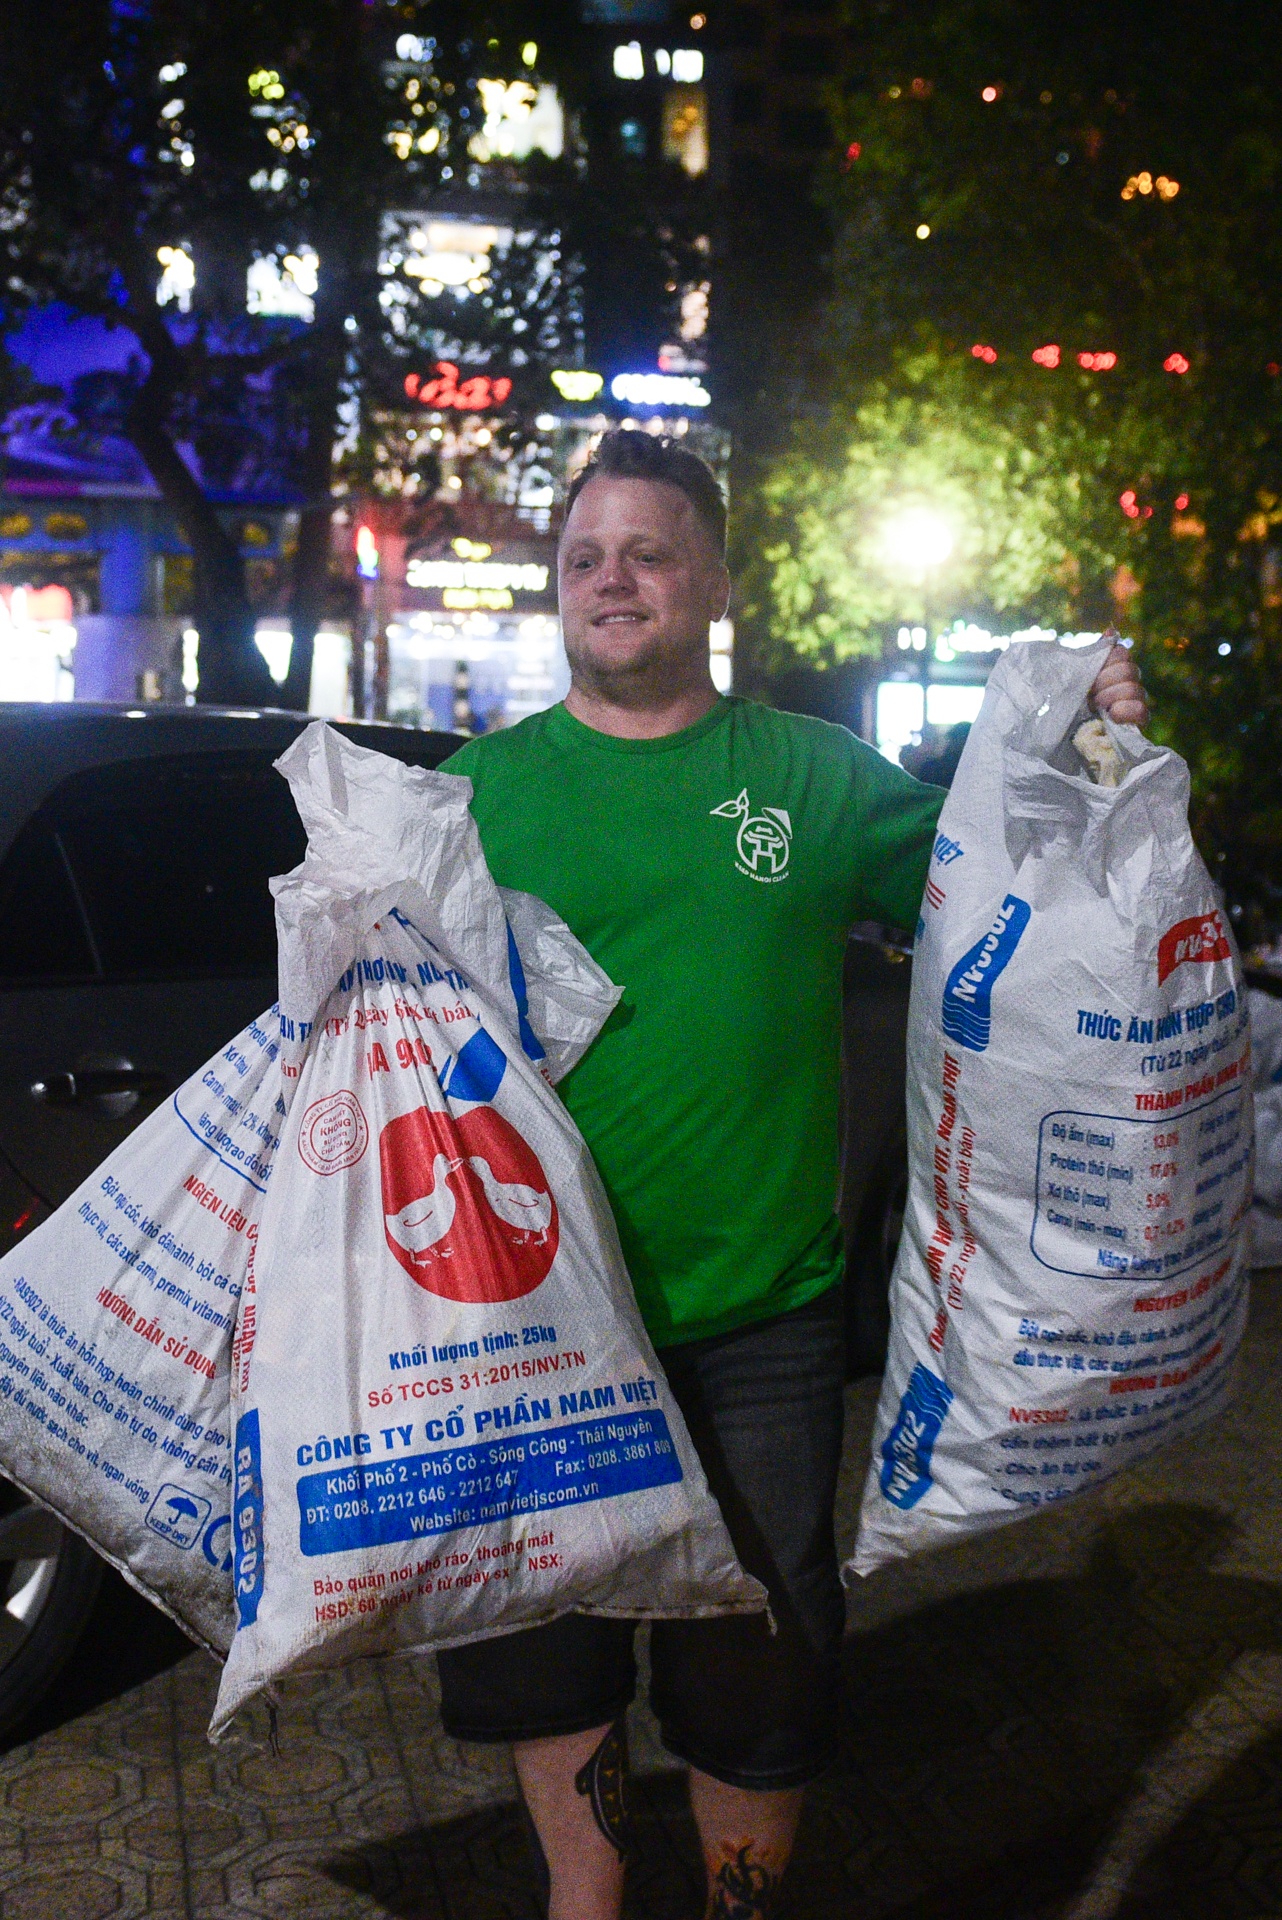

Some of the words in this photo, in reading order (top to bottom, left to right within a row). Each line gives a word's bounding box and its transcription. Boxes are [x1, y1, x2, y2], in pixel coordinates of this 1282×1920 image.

[1077, 1009, 1122, 1041] THỨC
[1126, 1015, 1153, 1044] ĂN
[949, 1264, 967, 1284] 22
[958, 1126, 977, 1158] bán)
[106, 1232, 123, 1252] các
[154, 1276, 193, 1308] premix
[196, 1258, 216, 1281] bột
[214, 1273, 231, 1290] cá
[133, 1317, 165, 1346] DẪN
[163, 1336, 188, 1359] SỬ
[389, 1344, 428, 1371] Khối
[432, 1341, 479, 1364] lượng
[483, 1331, 519, 1355] tịnh:
[523, 1325, 557, 1346] 25kg
[30, 1368, 48, 1392] liệu
[48, 1387, 66, 1407] nào
[38, 1303, 51, 1322] là
[46, 1313, 67, 1340] thức
[65, 1331, 79, 1351] ăn
[77, 1342, 98, 1367] hỗn
[94, 1357, 115, 1383] hợp
[115, 1372, 143, 1401] hoàn
[175, 1412, 204, 1440] dùng
[204, 1428, 225, 1447] cho
[368, 1384, 394, 1408] Số
[398, 1377, 454, 1401] TCCS
[460, 1350, 586, 1391] 31:2015/NV.TN
[92, 1390, 114, 1414] Cho
[114, 1405, 129, 1425] ăn
[129, 1416, 144, 1436] tự
[142, 1426, 158, 1448] do,
[161, 1436, 197, 1469] không
[197, 1455, 219, 1476] cần
[296, 1435, 372, 1467] CÔNG
[380, 1424, 414, 1450] TY
[425, 1404, 465, 1442] CỔ
[474, 1393, 551, 1434] PHẦN
[559, 1386, 615, 1417] NAM
[621, 1376, 658, 1406] VIỆT
[67, 1436, 86, 1455] cho
[101, 1460, 125, 1483] ngan
[238, 1447, 253, 1500] RA
[306, 1506, 330, 1525] ĐT:
[334, 1500, 375, 1520] 0208.
[378, 1491, 415, 1513] 2212
[418, 1486, 446, 1505] 646
[459, 1475, 492, 1497] 2212
[495, 1470, 518, 1489] 647
[555, 1459, 585, 1477] Fax:
[588, 1451, 621, 1470] 0208.
[624, 1445, 653, 1462] 3861
[326, 1470, 360, 1495] Khối
[364, 1463, 396, 1489] Phố
[398, 1465, 408, 1483] 2
[421, 1453, 453, 1478] Phố
[456, 1453, 477, 1472] Cò
[489, 1445, 526, 1466] Sông
[528, 1437, 567, 1457] Công
[577, 1428, 604, 1446] Thái
[607, 1418, 653, 1442] Nguyên
[150, 1517, 172, 1535] KEEP
[172, 1528, 191, 1546] DRY
[410, 1507, 476, 1533] Website:
[480, 1481, 599, 1518] namvietjscom.vn
[238, 1506, 257, 1598] 9302
[313, 1576, 343, 1597] Bảo
[348, 1569, 385, 1594] quản
[417, 1557, 441, 1577] khô
[477, 1537, 523, 1562] thoáng
[528, 1531, 555, 1549] mát
[315, 1603, 353, 1623] HSD:
[358, 1599, 375, 1615] 60
[437, 1577, 452, 1595] từ
[456, 1569, 490, 1588] ngày
[528, 1554, 563, 1573] NSX:
